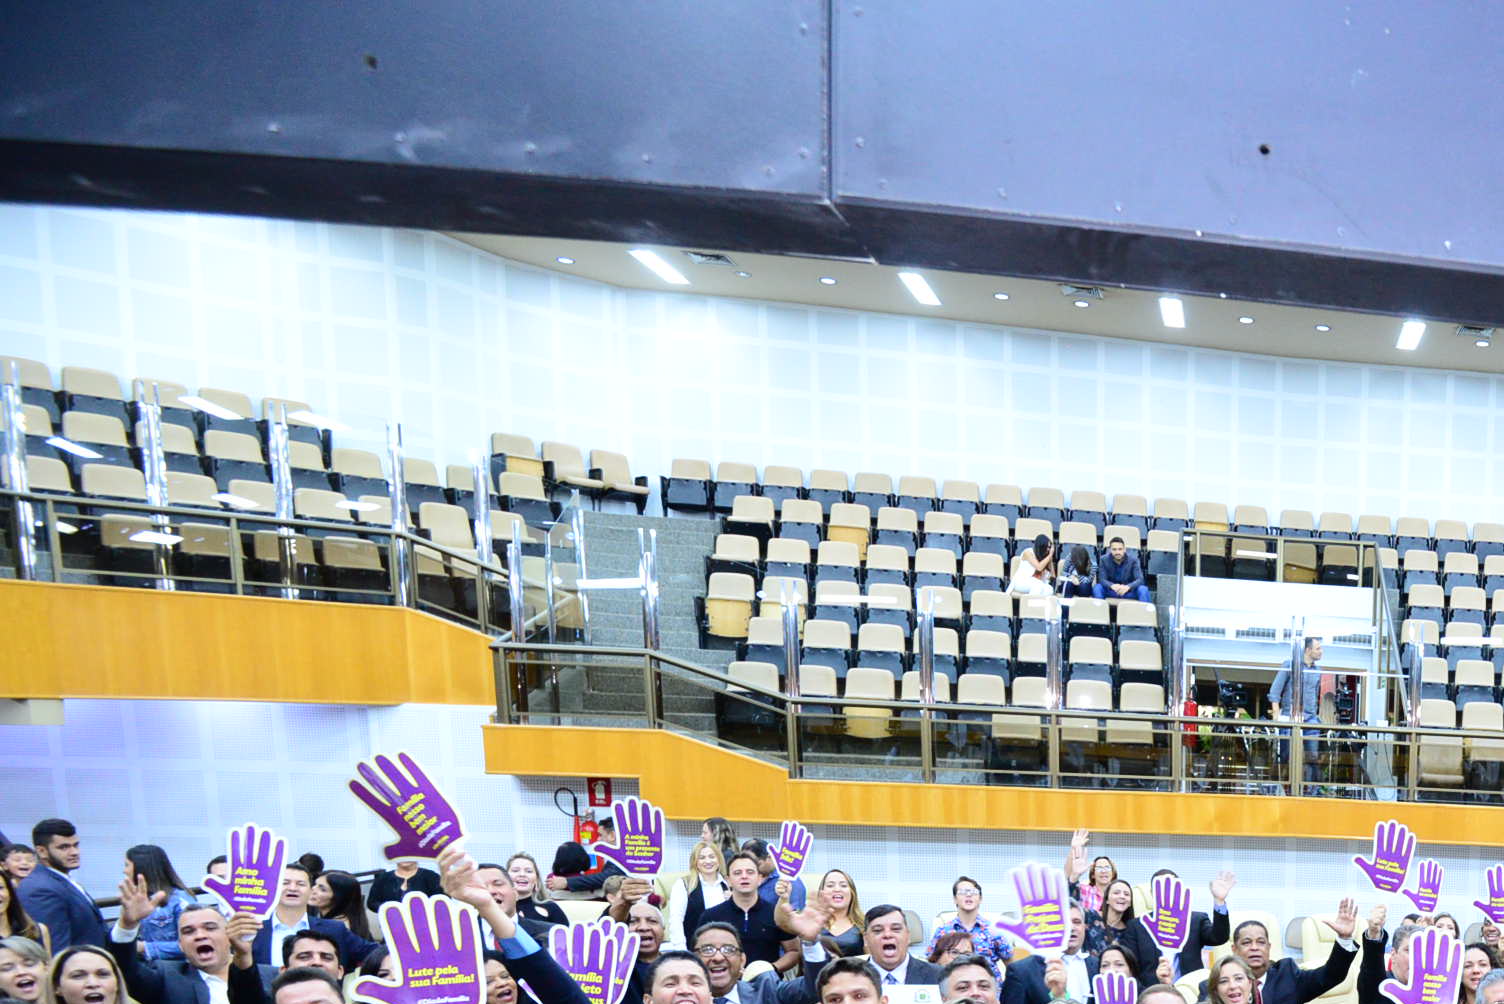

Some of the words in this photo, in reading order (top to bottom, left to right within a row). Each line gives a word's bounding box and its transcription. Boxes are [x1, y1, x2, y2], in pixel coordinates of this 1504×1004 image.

[396, 792, 426, 814] Família
[235, 866, 259, 877] Amo
[234, 885, 268, 896] Família
[408, 968, 434, 978] Lute
[435, 965, 459, 977] pela
[1424, 973, 1448, 982] Família
[409, 979, 431, 988] sua
[432, 974, 474, 985] Família!
[569, 972, 602, 984] amília
